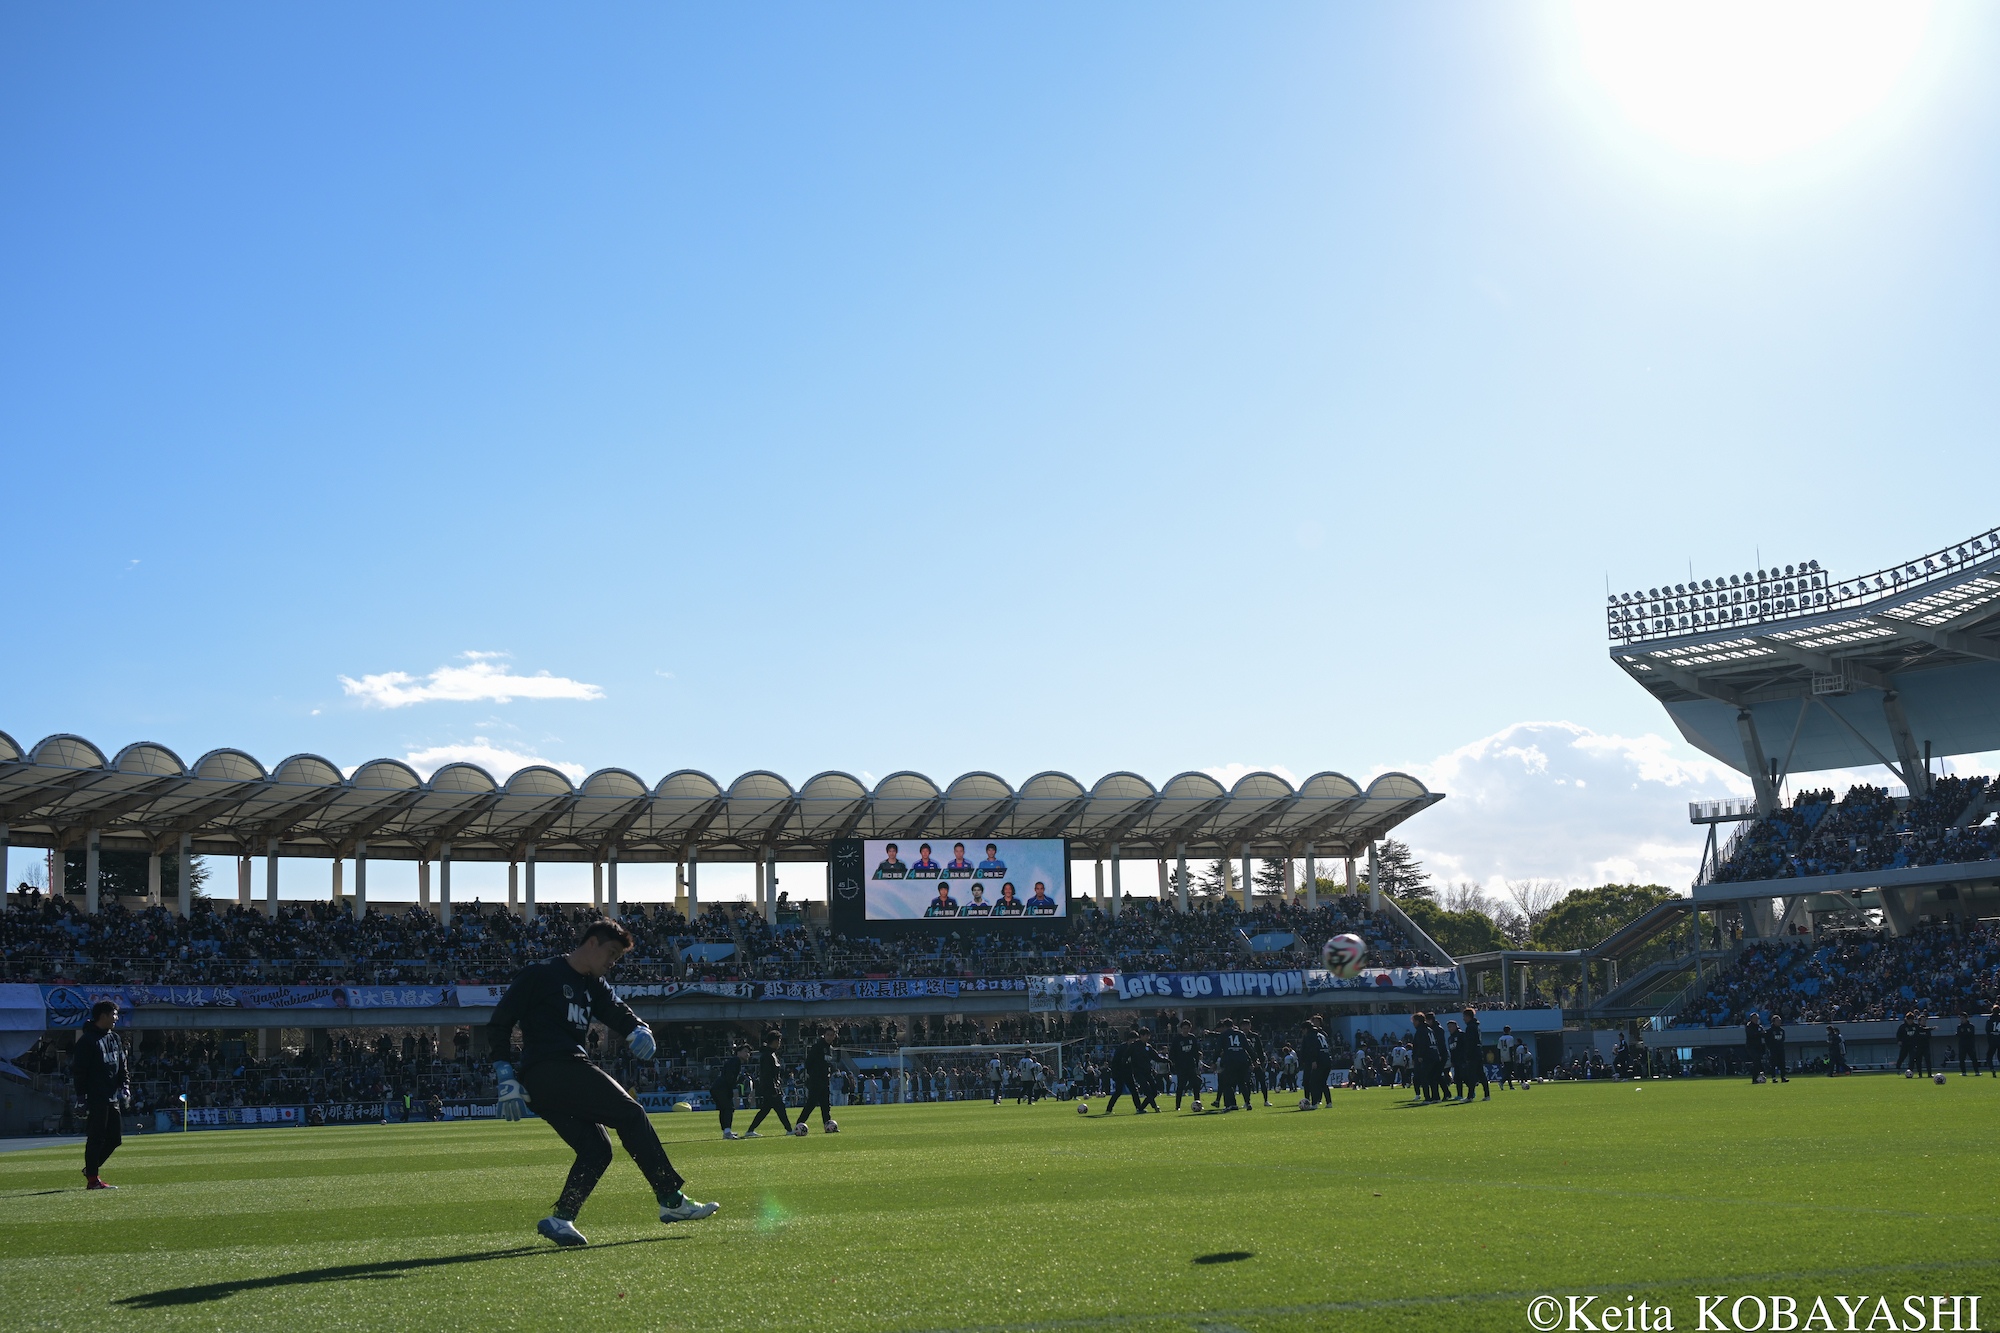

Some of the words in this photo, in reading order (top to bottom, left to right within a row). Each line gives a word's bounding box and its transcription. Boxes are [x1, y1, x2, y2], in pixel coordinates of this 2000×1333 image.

[877, 869, 883, 879] 1
[908, 869, 916, 879] 4
[942, 869, 949, 878] 5
[977, 869, 984, 878] 6
[1116, 974, 1172, 1000] Let's
[1180, 975, 1212, 998] go
[1219, 971, 1302, 996] NIPPON
[250, 987, 290, 1005] Yasuto
[1229, 1035, 1240, 1047] 14
[1501, 1040, 1508, 1049] 14
[442, 1104, 470, 1117] andro
[471, 1103, 498, 1117] Dami
